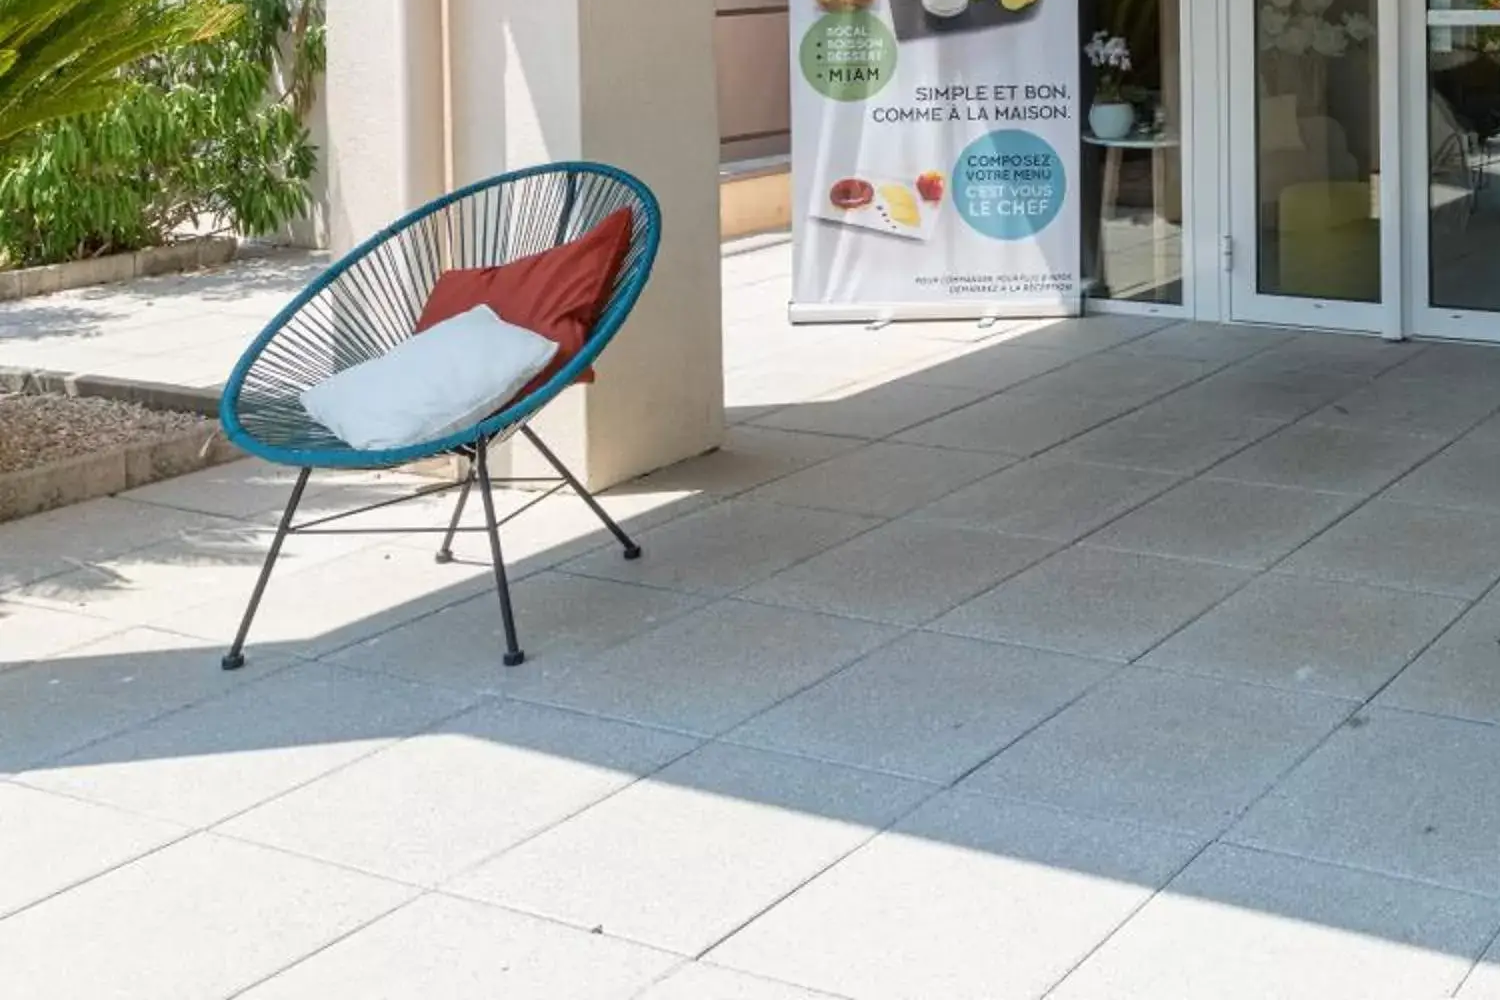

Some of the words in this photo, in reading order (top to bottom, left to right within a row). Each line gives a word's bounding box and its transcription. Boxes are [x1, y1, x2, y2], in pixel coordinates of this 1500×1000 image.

[829, 67, 879, 82] MIAM
[915, 86, 988, 101] SIMPLE
[993, 85, 1019, 100] ET
[872, 107, 943, 122] COMME
[967, 106, 990, 121] LA
[967, 154, 1051, 167] COMPOSEZ
[965, 169, 1010, 181] VOTRE
[1013, 169, 1052, 180] MENU
[1010, 184, 1053, 197] VOUS
[969, 201, 991, 217] LE
[997, 200, 1048, 215] CHEF
